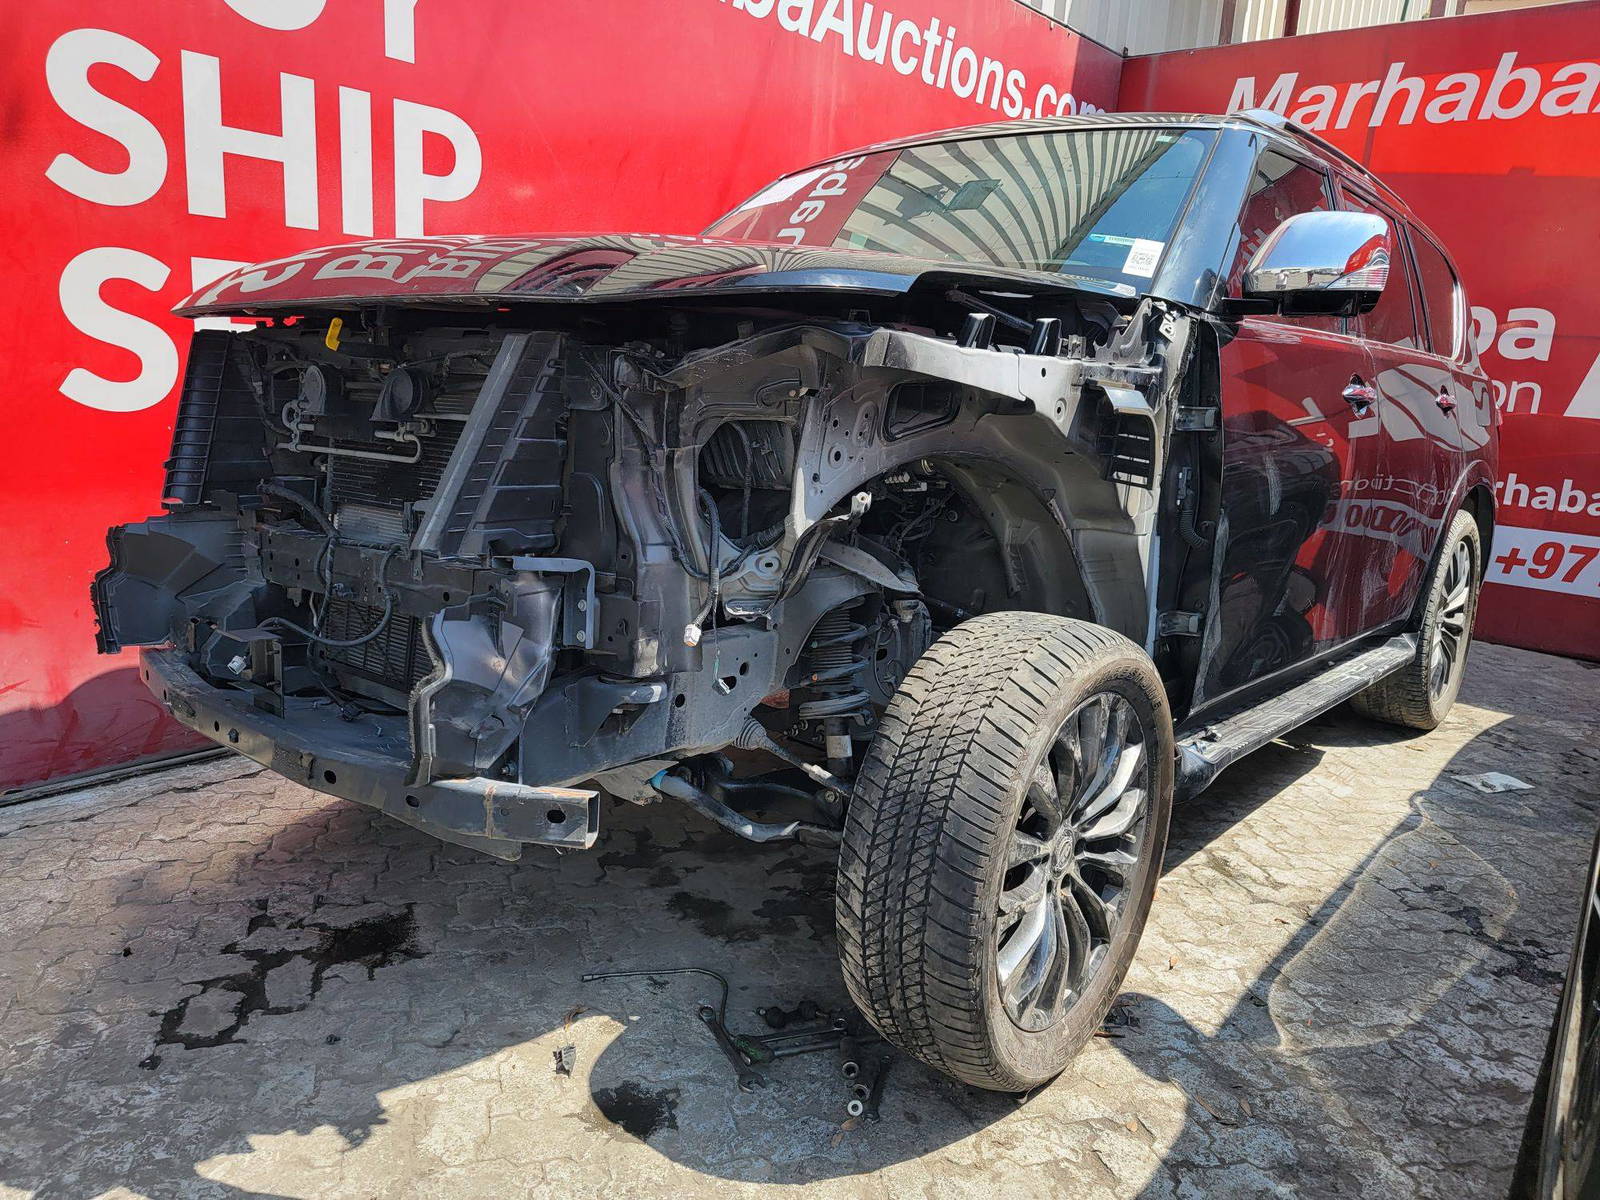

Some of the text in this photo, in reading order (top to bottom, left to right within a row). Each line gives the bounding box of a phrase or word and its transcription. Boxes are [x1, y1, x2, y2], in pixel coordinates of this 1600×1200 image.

[718, 0, 1105, 119] aAuctions.co
[1226, 51, 1600, 132] Marhaba
[45, 28, 482, 238] SHIP
[1495, 541, 1600, 587] +97
